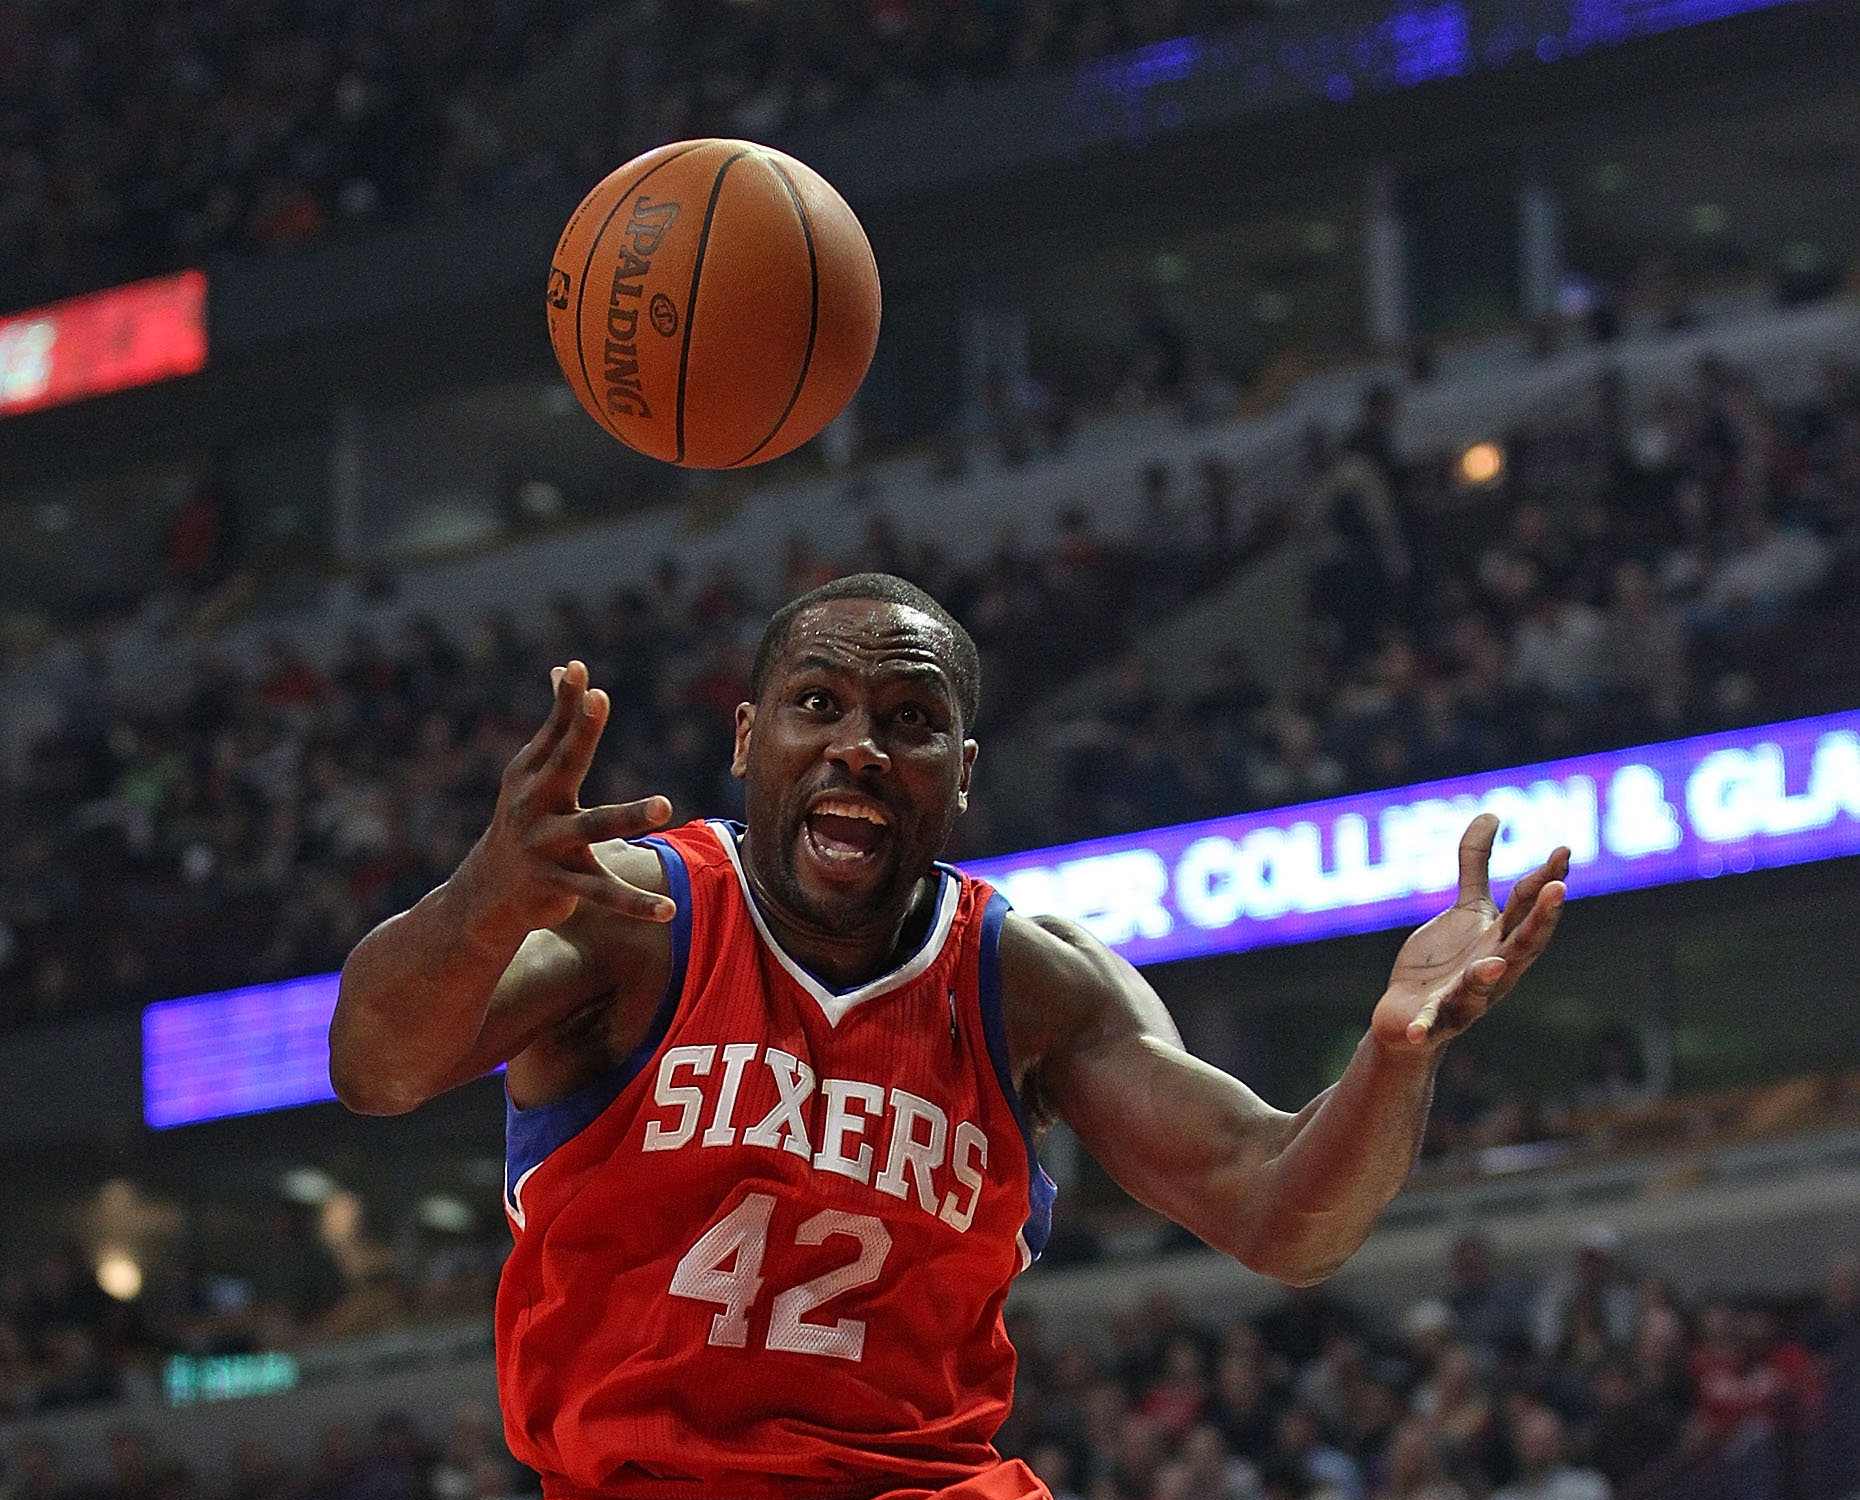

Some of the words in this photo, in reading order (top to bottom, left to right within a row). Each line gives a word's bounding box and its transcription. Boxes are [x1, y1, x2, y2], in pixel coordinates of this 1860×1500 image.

[603, 195, 681, 419] SPALDING
[1174, 775, 1600, 932] COLLISON
[1605, 763, 1684, 860] &
[642, 1043, 988, 1233] SIXERS
[668, 1192, 893, 1362] 42
